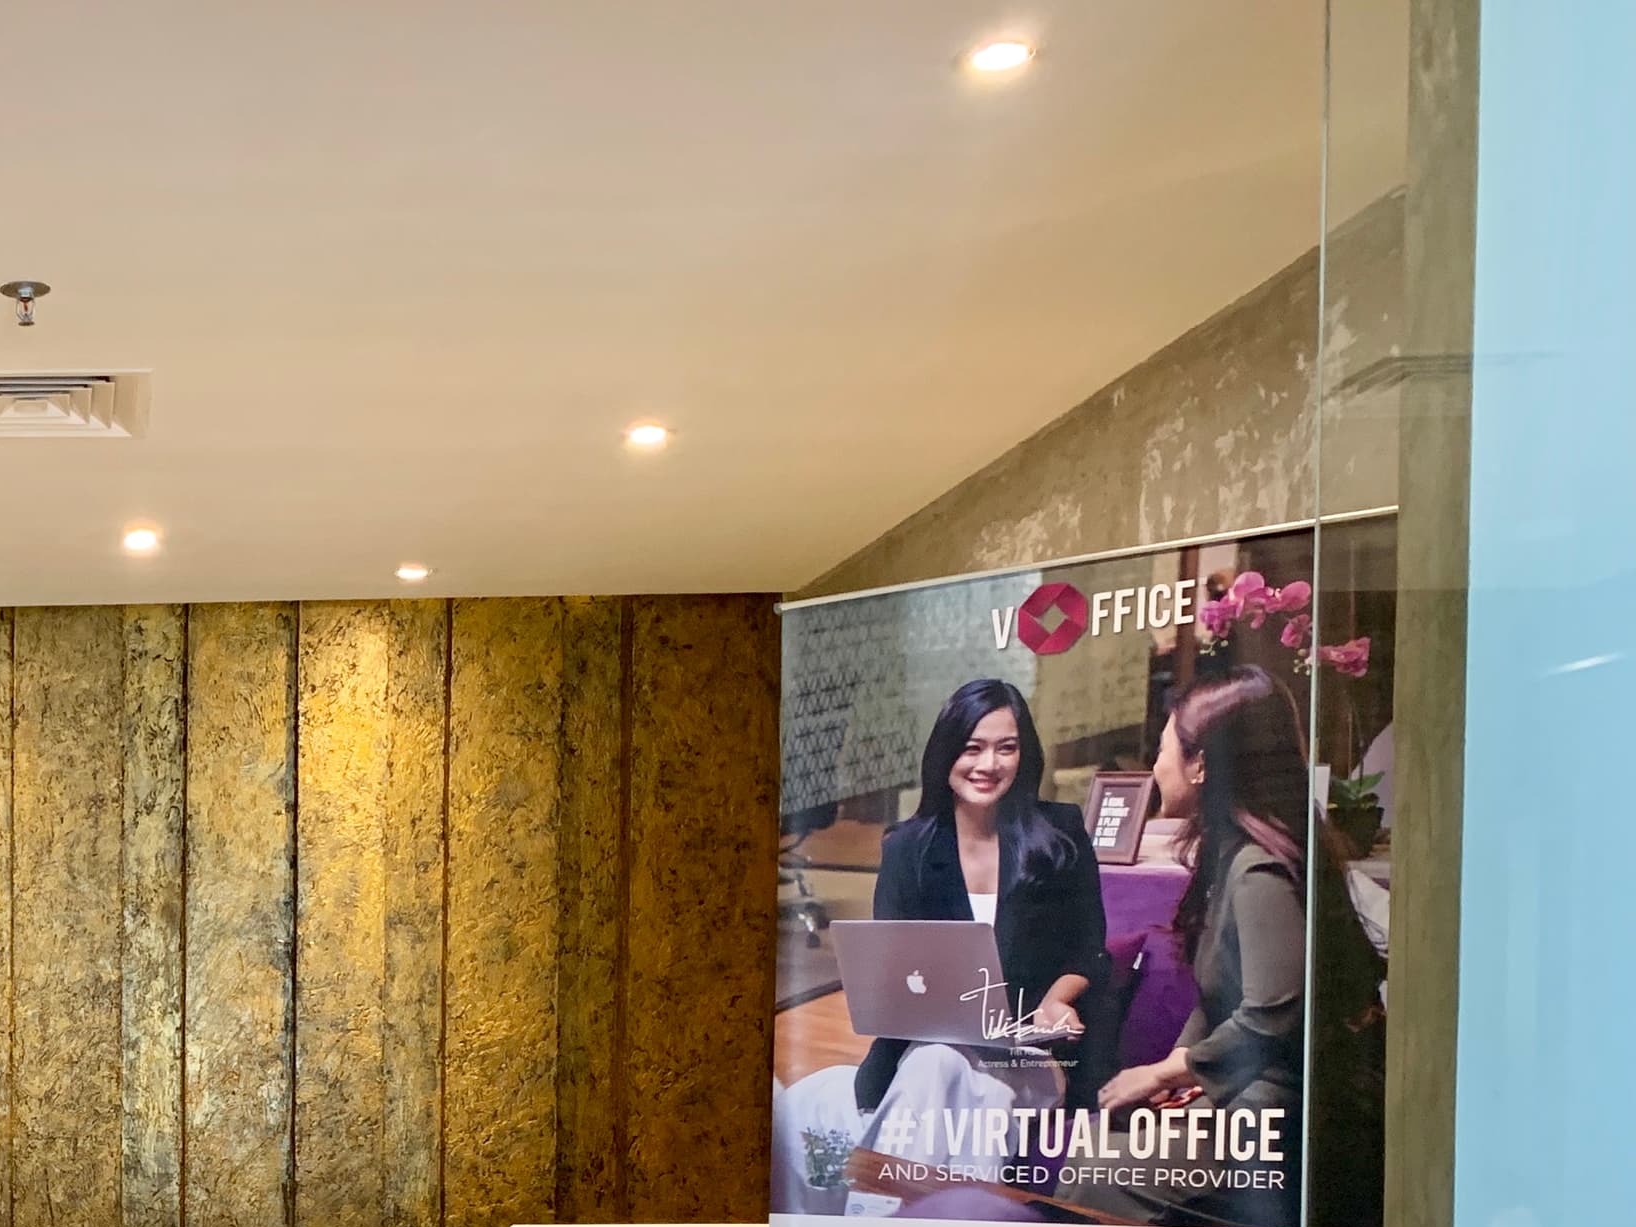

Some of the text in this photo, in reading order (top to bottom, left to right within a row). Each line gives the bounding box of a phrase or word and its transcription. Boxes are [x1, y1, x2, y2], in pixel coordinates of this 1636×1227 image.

[877, 1107, 1284, 1162] #1 VIRTUAL OFFICE
[878, 1163, 1285, 1190] AND SERVICED OFFICE PROVIDER
